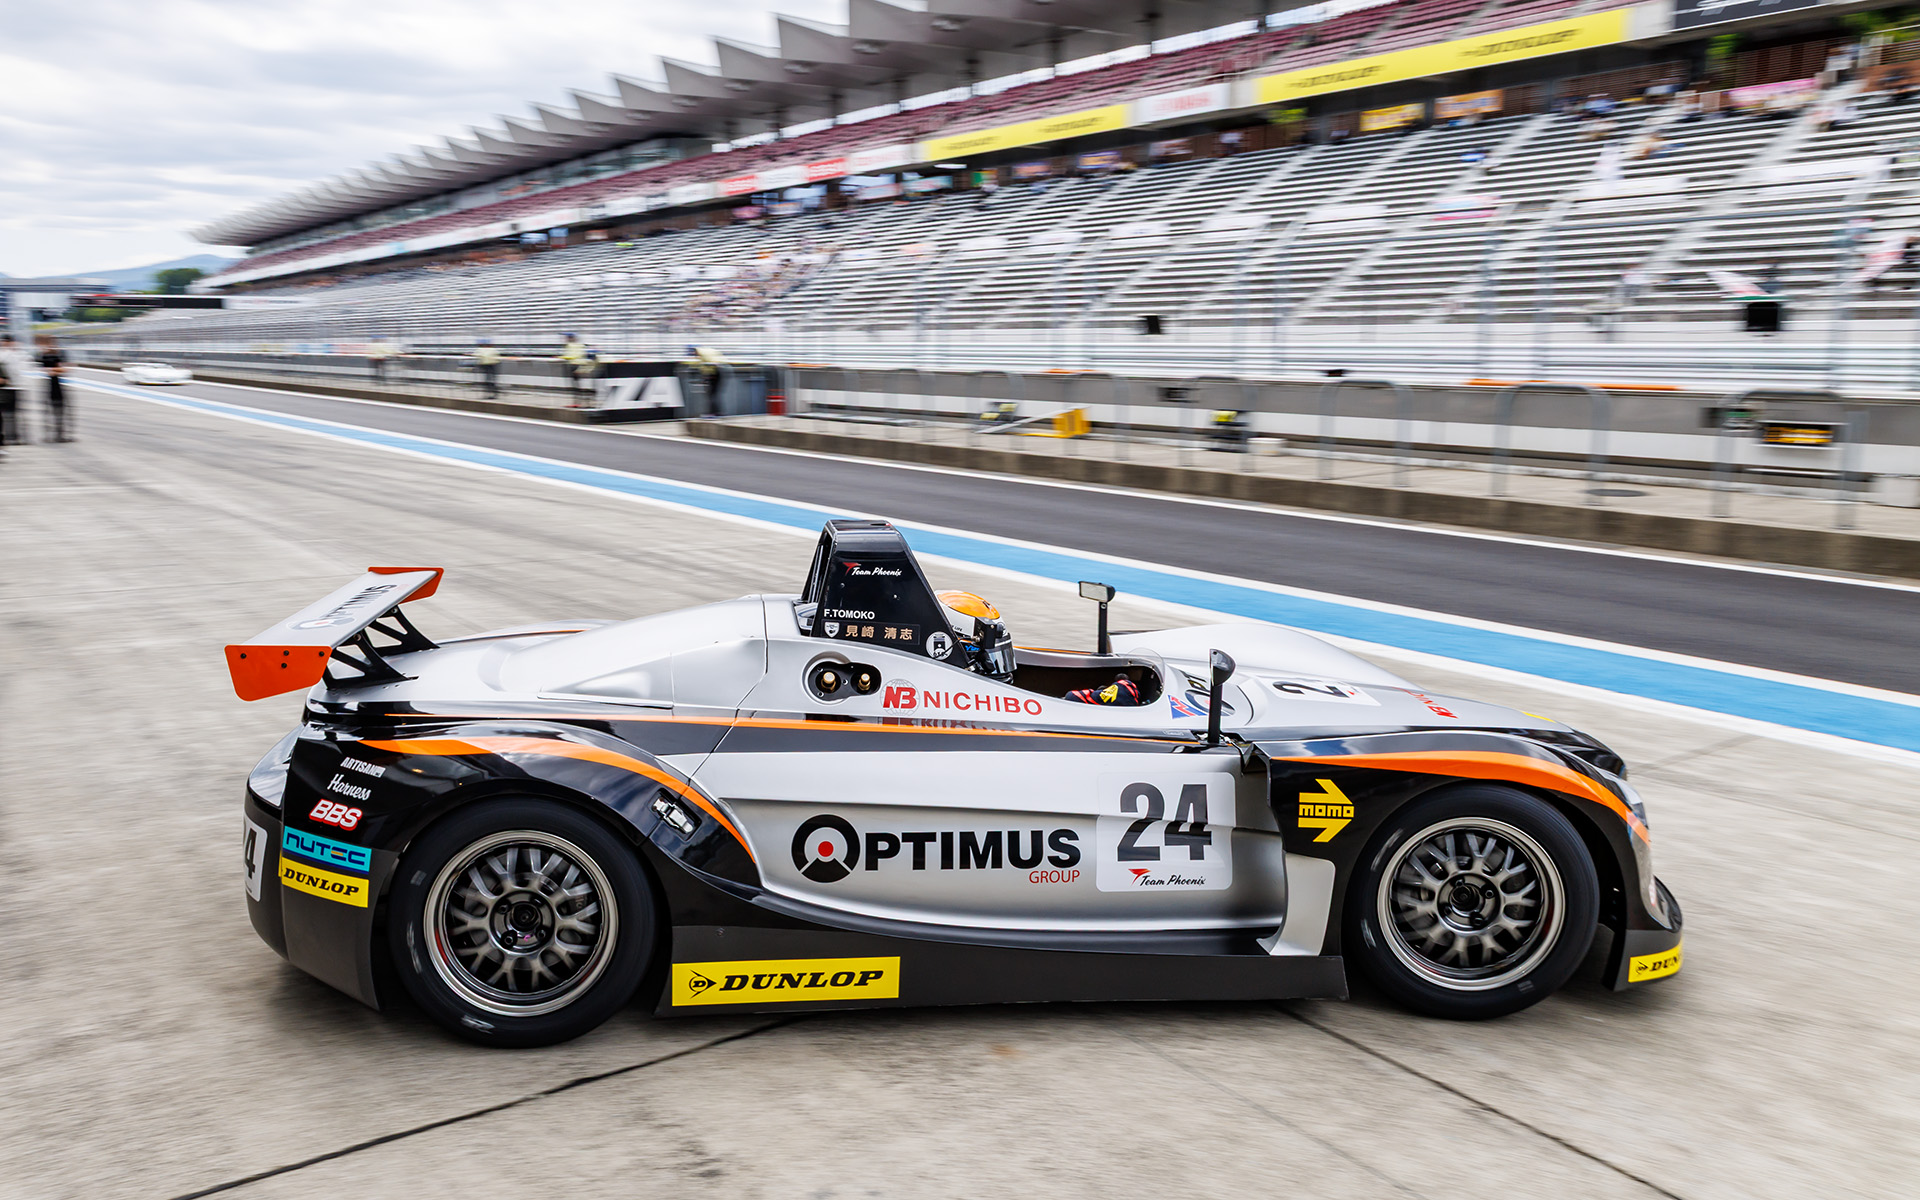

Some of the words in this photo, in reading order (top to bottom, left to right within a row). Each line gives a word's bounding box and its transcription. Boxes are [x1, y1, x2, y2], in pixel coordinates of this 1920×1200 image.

[851, 566, 871, 577] Team
[871, 566, 903, 577] Phoenix
[823, 608, 876, 620] F.TOMOKO
[923, 690, 1043, 716] NICHIBO
[340, 756, 377, 775] ARTISAN
[327, 773, 372, 801] Harness
[309, 799, 363, 831] BBS
[1117, 782, 1212, 862] 24
[791, 813, 1082, 884] OPTIMUS
[283, 867, 360, 896] DUNLOP
[1028, 869, 1081, 884] GROUP
[1139, 874, 1166, 887] Team
[1166, 874, 1207, 887] Phoenix
[718, 970, 884, 992] DUNLOP
